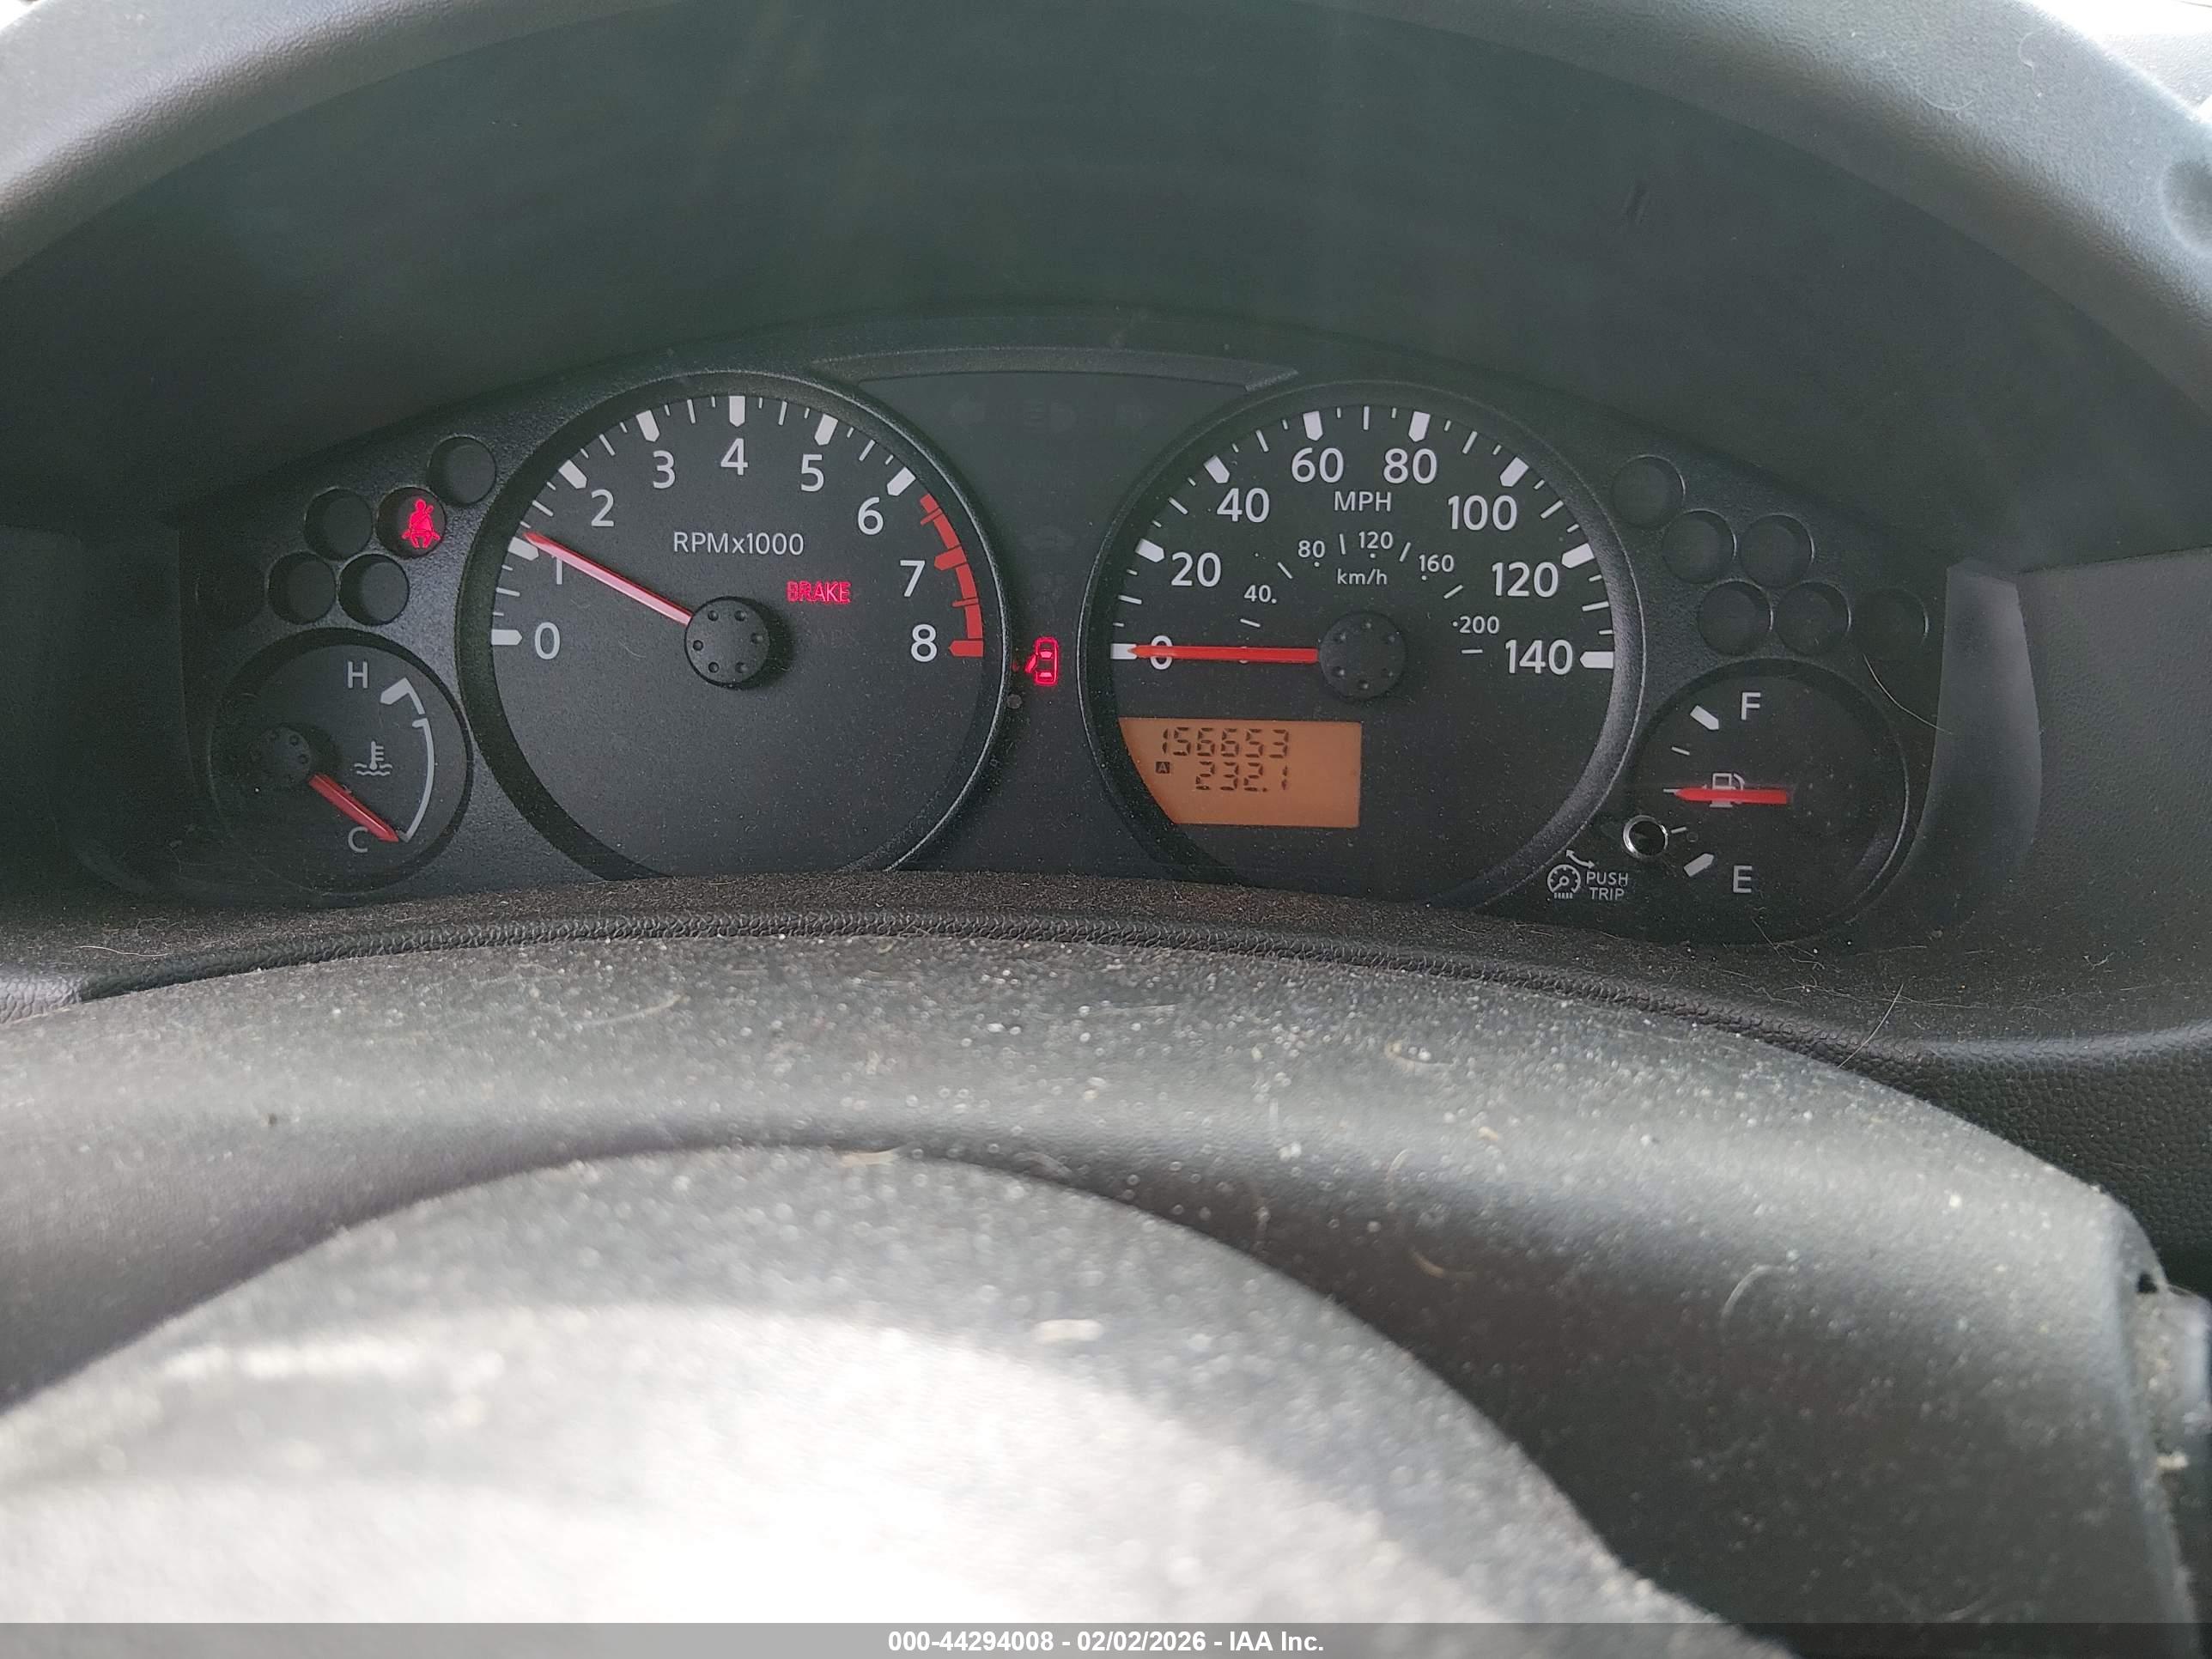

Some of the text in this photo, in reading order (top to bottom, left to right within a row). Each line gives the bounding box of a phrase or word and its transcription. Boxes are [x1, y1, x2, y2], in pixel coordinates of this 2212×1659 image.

[653, 450, 676, 489] 3
[720, 438, 749, 476] 4
[800, 453, 824, 492] 5
[1291, 447, 1344, 483] 60
[1383, 447, 1437, 484] 80
[591, 489, 614, 527] 2
[857, 496, 884, 535] 6
[1216, 487, 1270, 523] 40
[1334, 490, 1392, 512] MPH
[1448, 495, 1517, 531] 100
[673, 532, 804, 556] RPMx1000
[1297, 540, 1326, 558] 80
[1358, 531, 1394, 550] 120
[900, 560, 926, 597] 7
[1171, 551, 1221, 587] 20
[1337, 568, 1388, 586] km/h
[1419, 554, 1455, 573] 160
[1492, 562, 1559, 598] 120
[787, 580, 851, 605] BRAKE
[1243, 584, 1272, 603] 40
[534, 622, 561, 660] 0
[1459, 616, 1500, 635] 200
[910, 623, 938, 662] 8
[1150, 635, 1173, 670] 0
[1505, 639, 1573, 675] 140
[347, 660, 368, 689] H
[1741, 692, 1761, 720] F
[1162, 726, 1289, 759] 156653
[1195, 761, 1288, 792] 232.1
[348, 826, 368, 854] C
[1586, 871, 1629, 886] PUSH
[1589, 886, 1625, 901] TRIP
[1733, 865, 1753, 894] E
